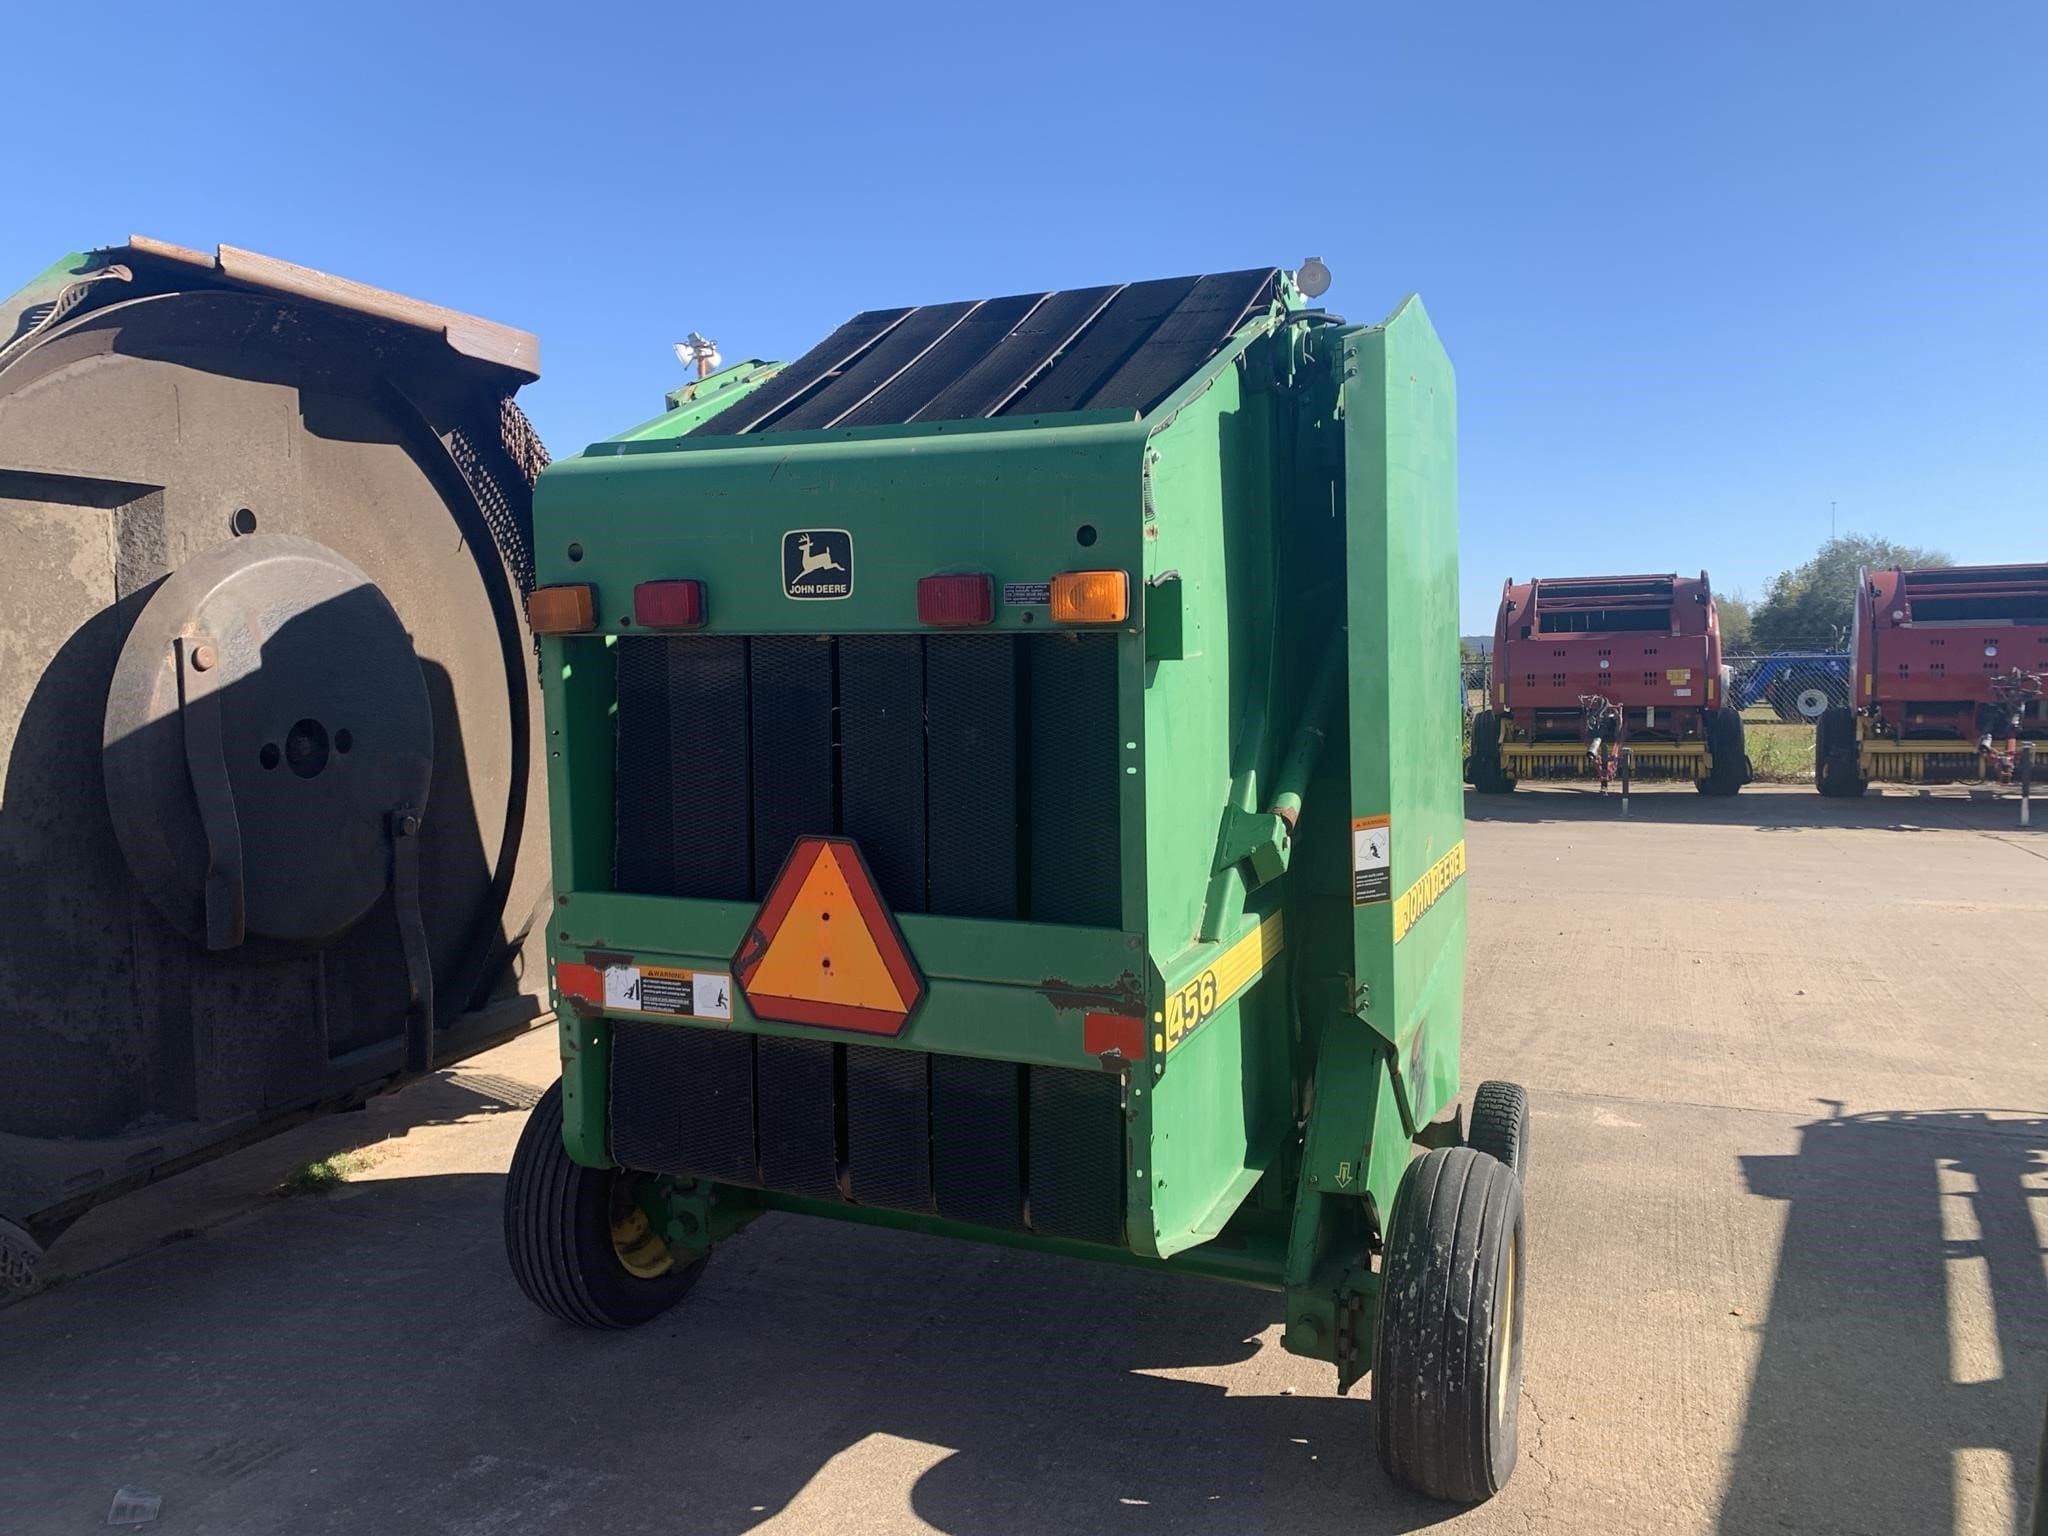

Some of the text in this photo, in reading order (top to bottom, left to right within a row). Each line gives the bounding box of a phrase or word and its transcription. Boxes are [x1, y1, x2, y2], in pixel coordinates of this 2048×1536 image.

[789, 584, 847, 594] JOHN DEERE
[1403, 872, 1434, 931] JOHN
[1433, 846, 1462, 899] DEERE
[653, 970, 686, 979] WARNING
[1168, 969, 1217, 1041] 456
